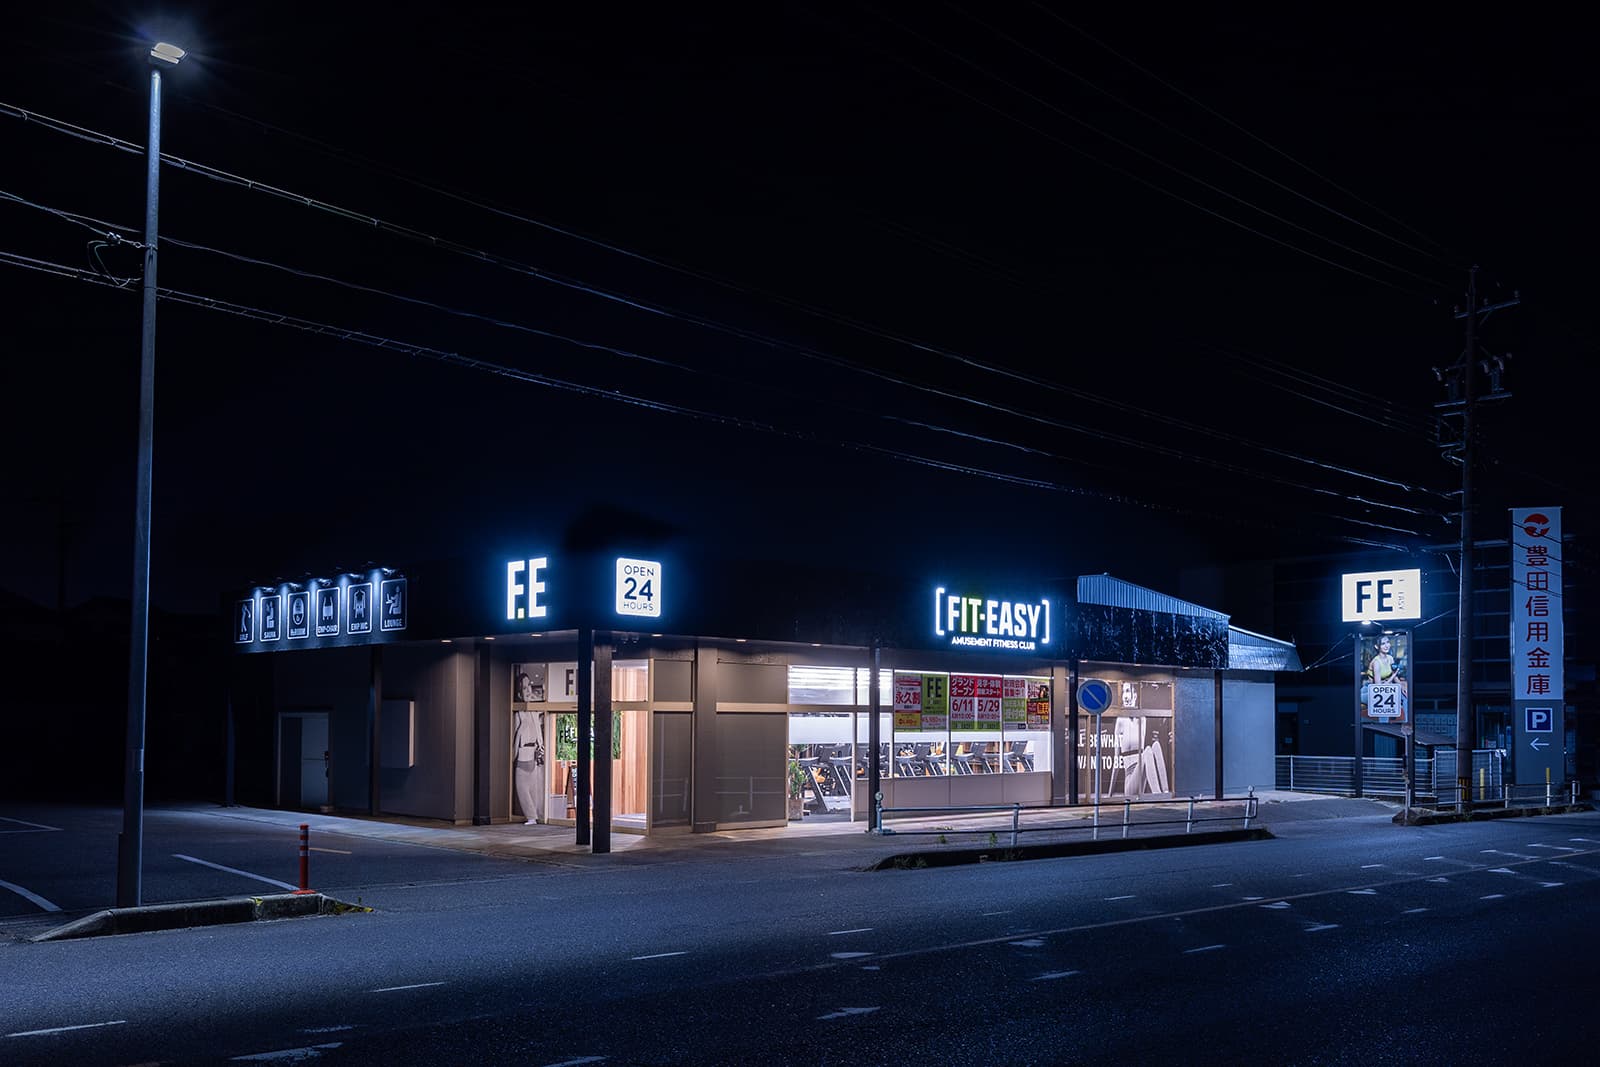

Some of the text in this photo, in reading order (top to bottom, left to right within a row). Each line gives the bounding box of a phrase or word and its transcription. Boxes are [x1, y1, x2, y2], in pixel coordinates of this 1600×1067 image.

[624, 565, 655, 576] OPEN
[624, 577, 653, 601] 24
[624, 602, 654, 611] HOURS
[384, 618, 403, 628] LOUNGE
[1525, 545, 1551, 695] 豊田信用金庫
[952, 636, 1036, 650] AMUSEMENT FITNESS CLUB
[951, 678, 974, 687] グランド
[951, 687, 975, 696] オープン
[952, 699, 973, 713] 6/11
[978, 700, 1000, 713] 5/29
[1373, 694, 1396, 708] 24
[1532, 711, 1547, 729] P
[1101, 734, 1123, 748] WHAT
[1102, 755, 1112, 769] TO
